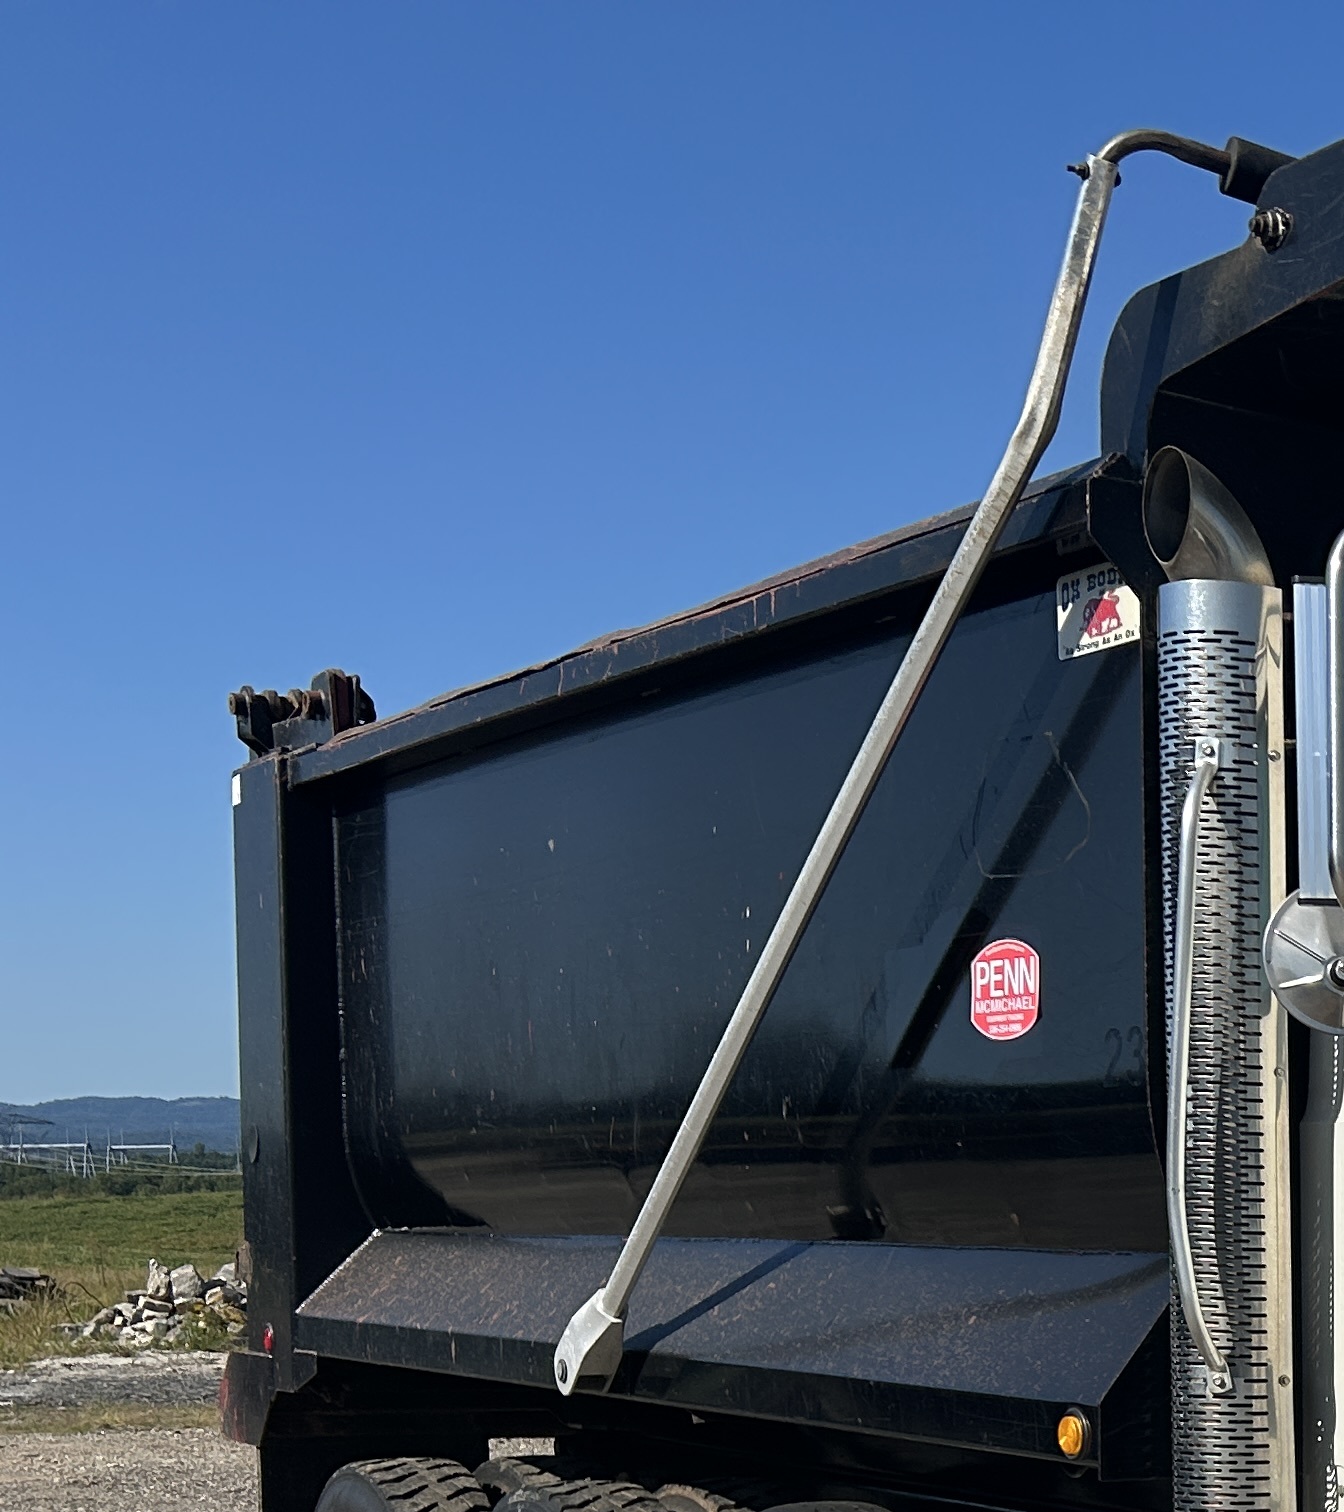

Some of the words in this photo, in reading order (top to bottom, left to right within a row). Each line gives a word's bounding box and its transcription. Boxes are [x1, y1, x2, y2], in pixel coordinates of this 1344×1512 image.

[1062, 578, 1081, 613] OX
[1076, 641, 1099, 653] Strong
[1102, 636, 1111, 645] As
[975, 955, 1036, 999] PENN
[975, 996, 1036, 1014] MCMICHAEL
